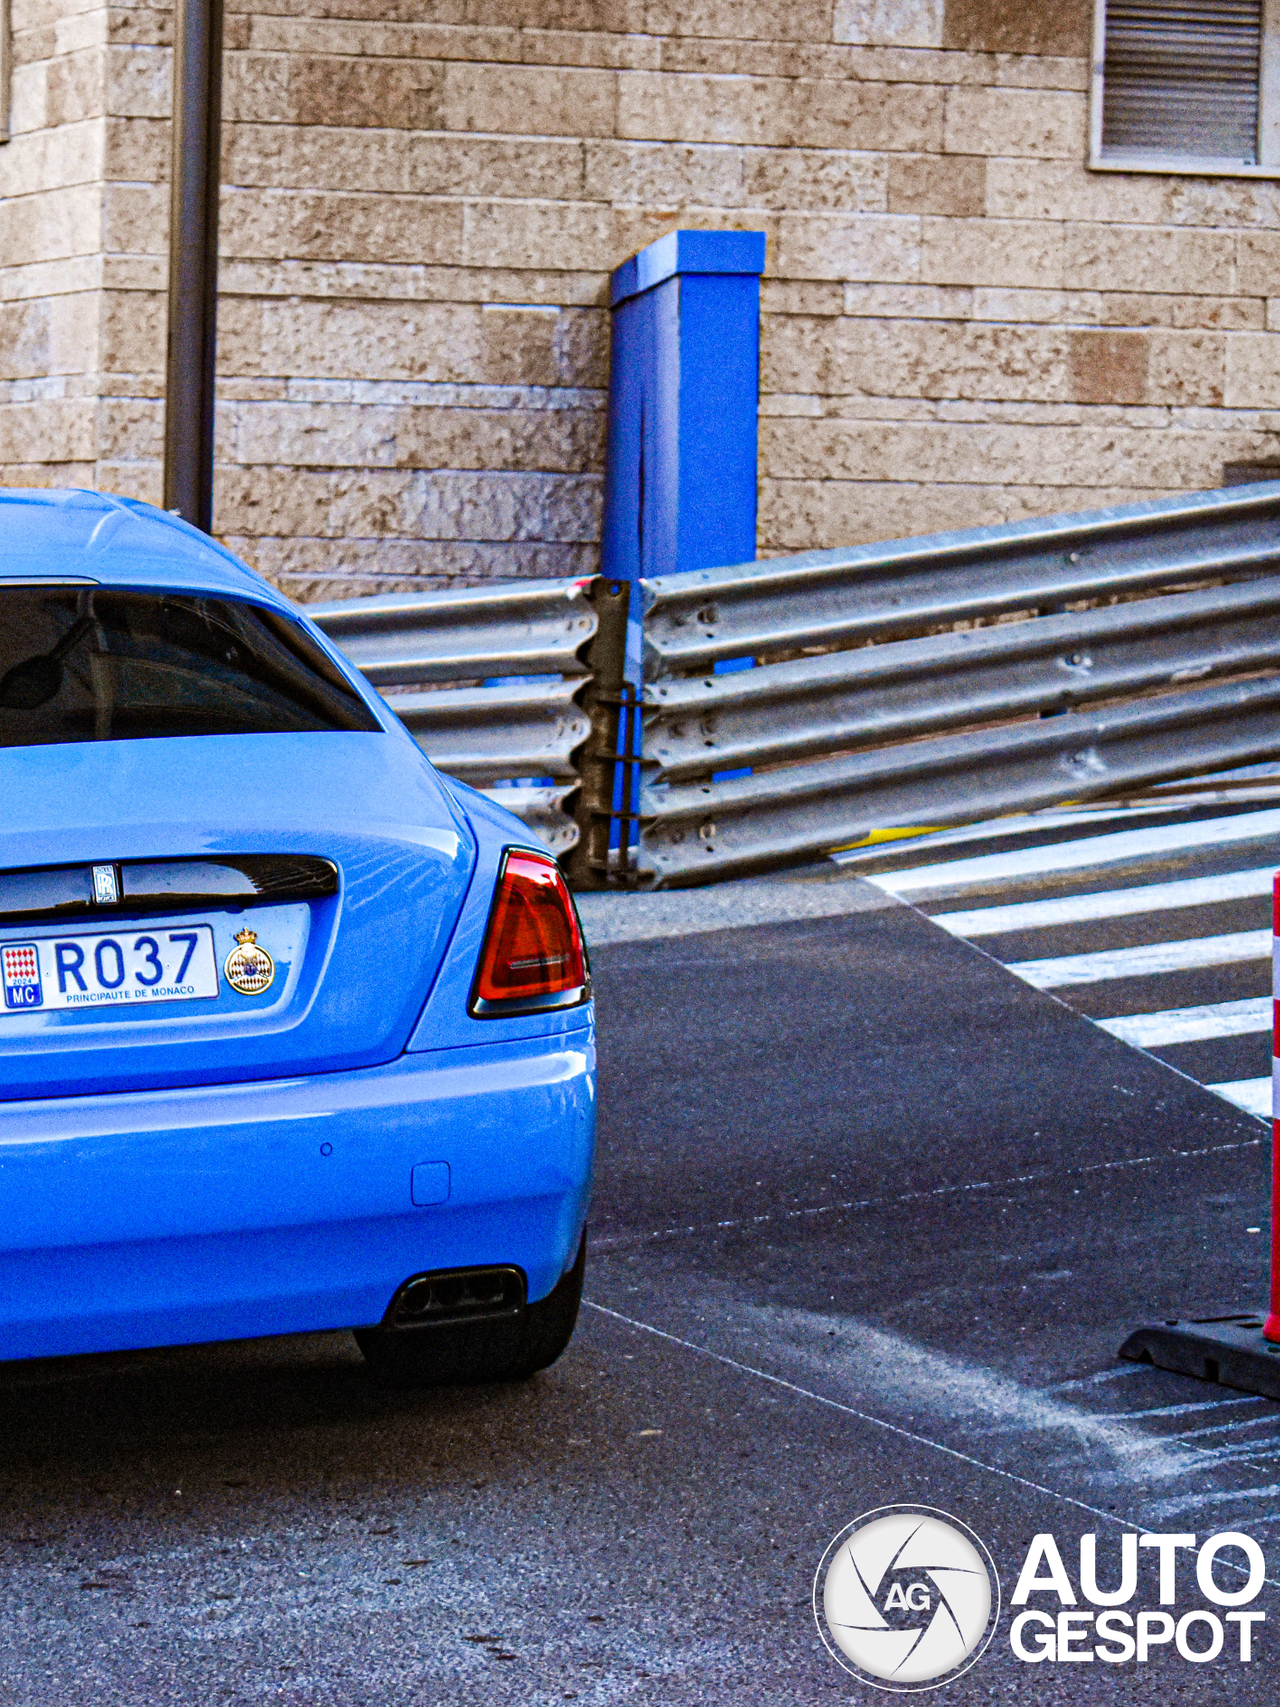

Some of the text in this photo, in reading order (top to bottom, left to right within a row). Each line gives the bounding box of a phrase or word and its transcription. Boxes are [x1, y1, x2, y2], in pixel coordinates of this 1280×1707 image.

[12, 986, 35, 1003] MC
[66, 985, 195, 1003] PRINCIPAUTE DE MONACO
